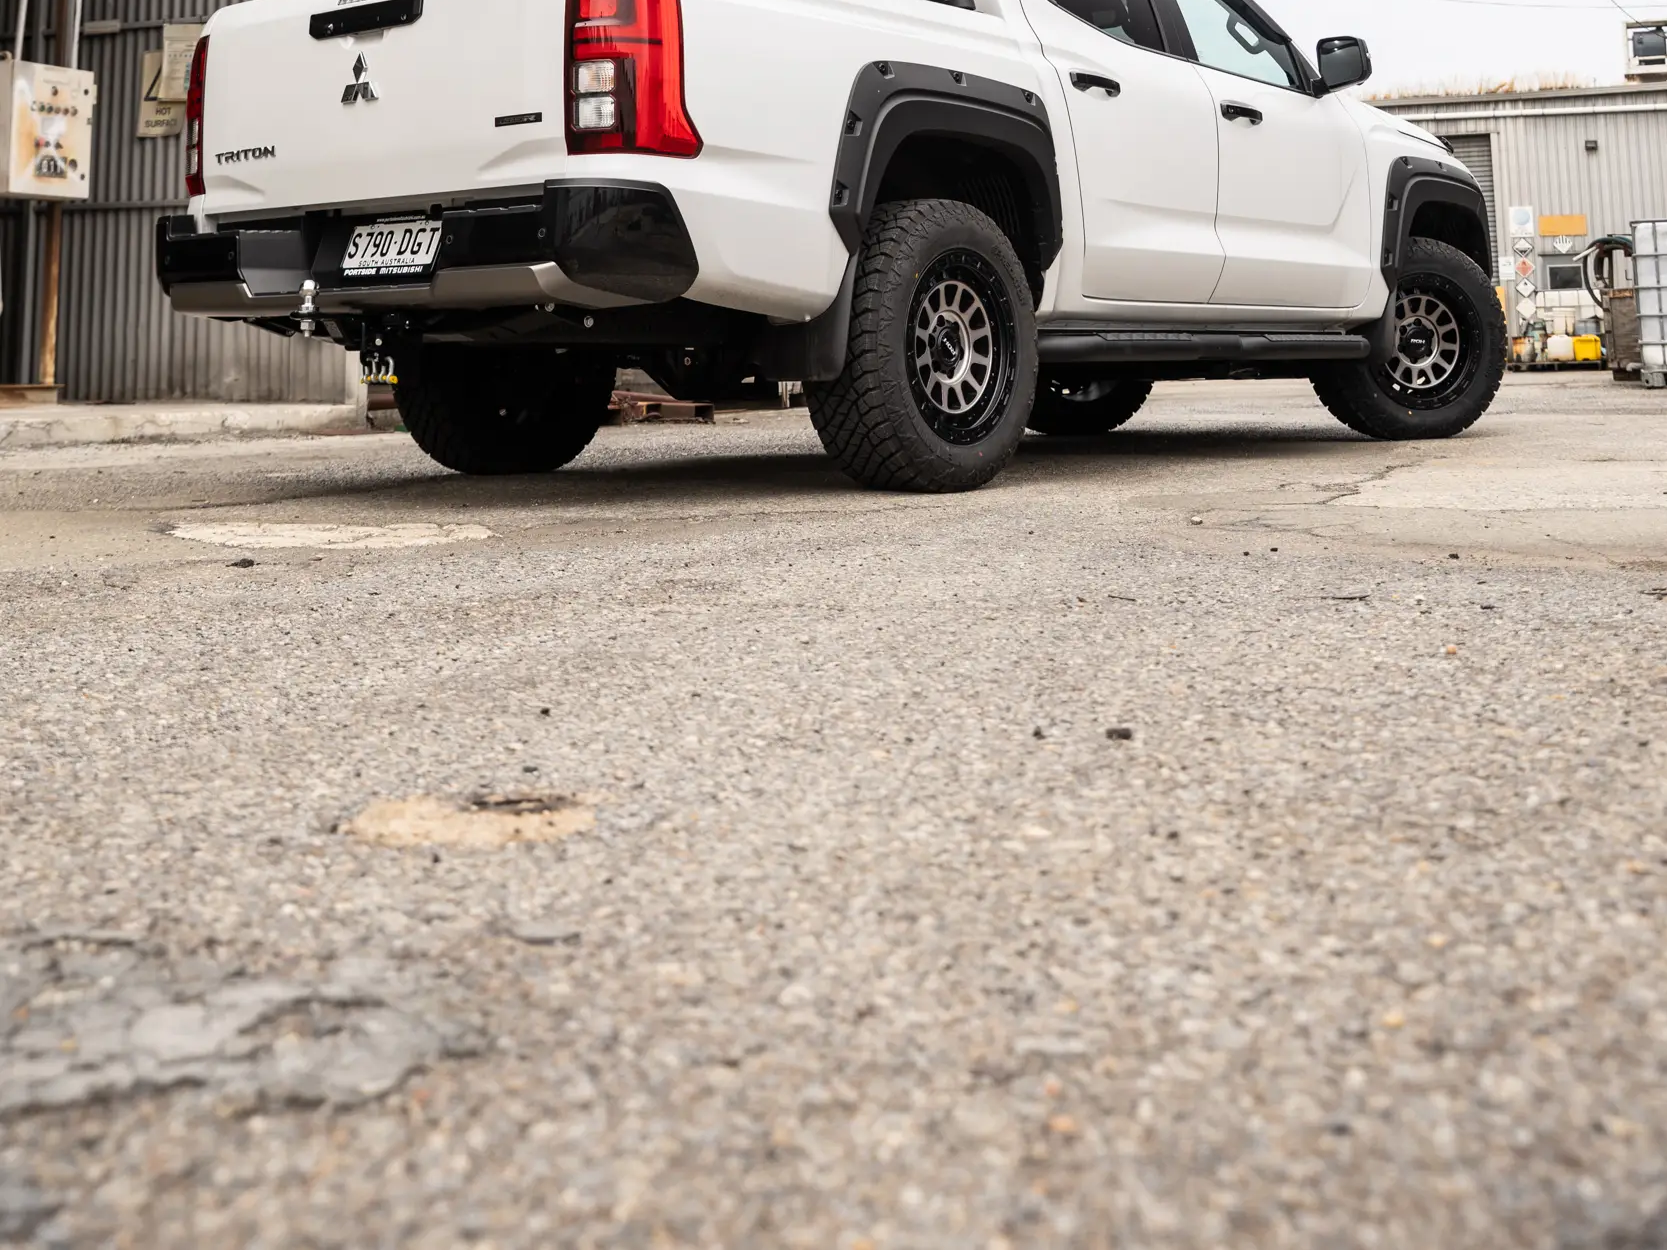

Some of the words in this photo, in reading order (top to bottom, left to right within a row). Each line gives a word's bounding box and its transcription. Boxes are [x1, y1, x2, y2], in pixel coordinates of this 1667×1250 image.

[155, 107, 171, 116] HOT
[215, 145, 276, 165] TRITON
[358, 259, 379, 267] SOUTH
[381, 257, 415, 266] AUSTRALIA
[344, 268, 377, 277] PORTSIDE
[379, 266, 423, 275] MITSUBISHI
